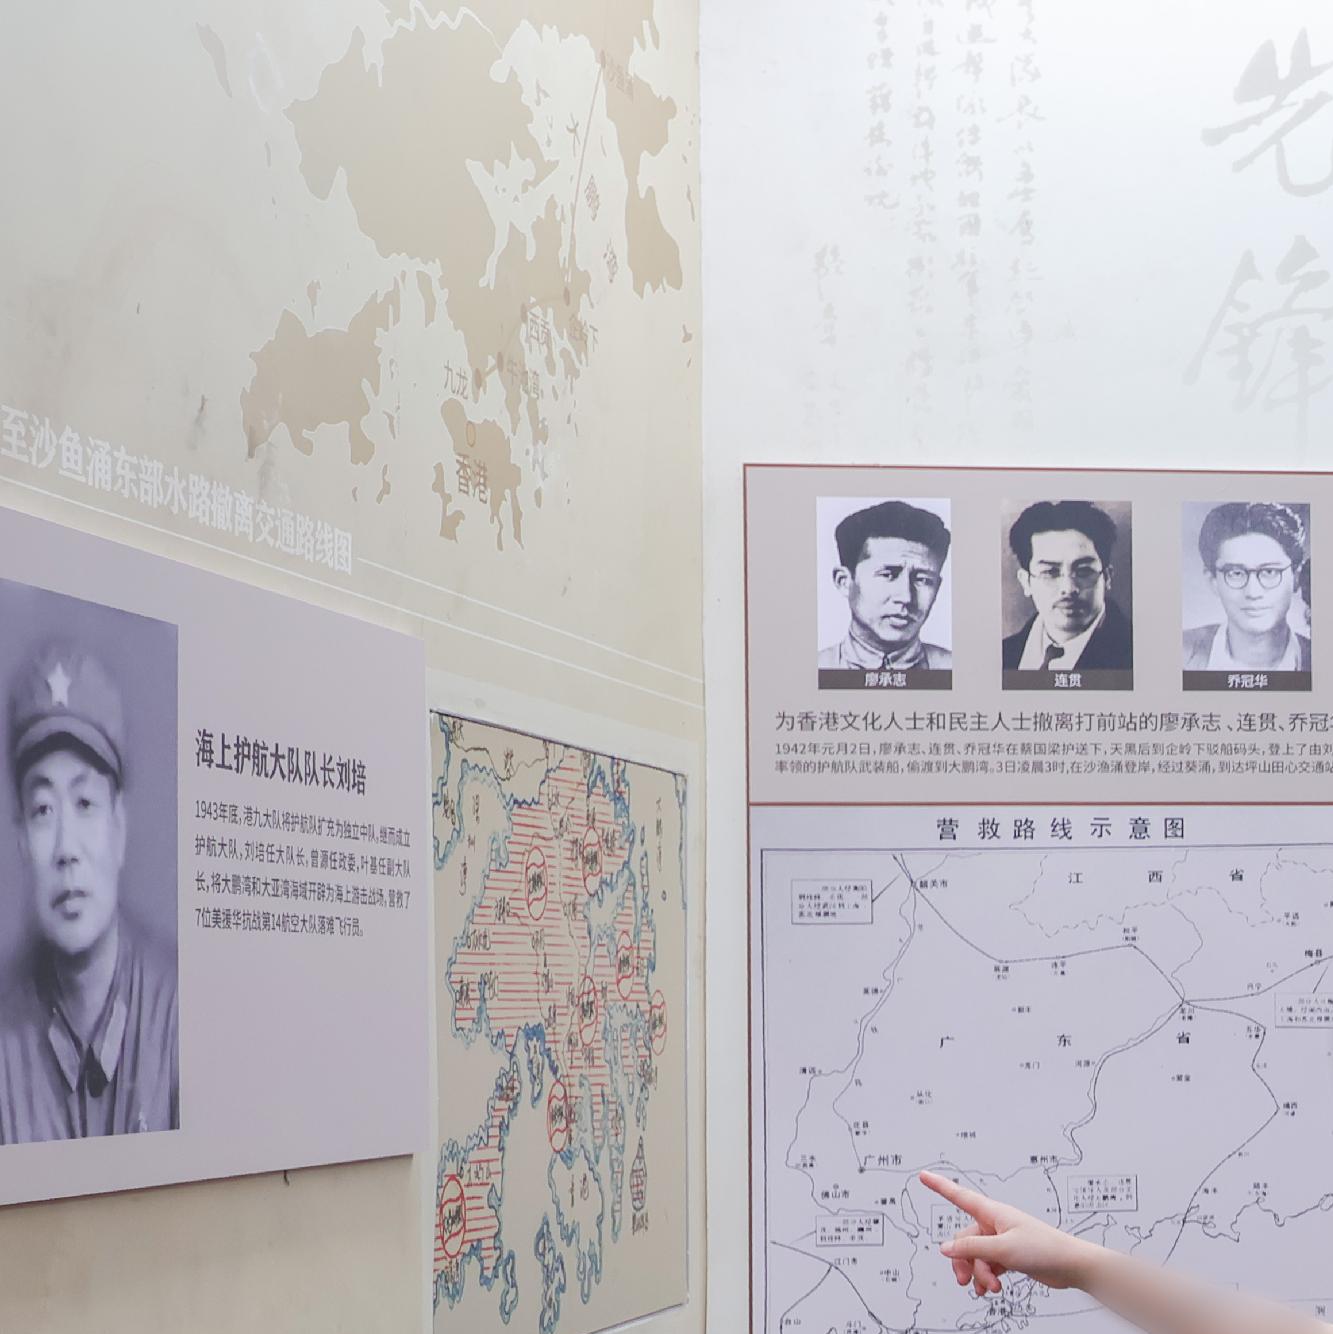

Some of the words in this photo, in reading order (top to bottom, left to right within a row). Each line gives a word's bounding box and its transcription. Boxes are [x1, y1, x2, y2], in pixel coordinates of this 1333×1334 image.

[444, 360, 469, 401] 九龙
[455, 453, 489, 504] 香港
[865, 672, 907, 688] 廖承志
[1055, 673, 1082, 688] 连贯
[1227, 673, 1268, 688] 乔冠华
[195, 729, 366, 796] 海上护航大队队长刘培
[936, 816, 1186, 841] 营救路线示意图
[863, 1154, 903, 1166] 广州市
[1029, 1154, 1059, 1165] 惠州市
